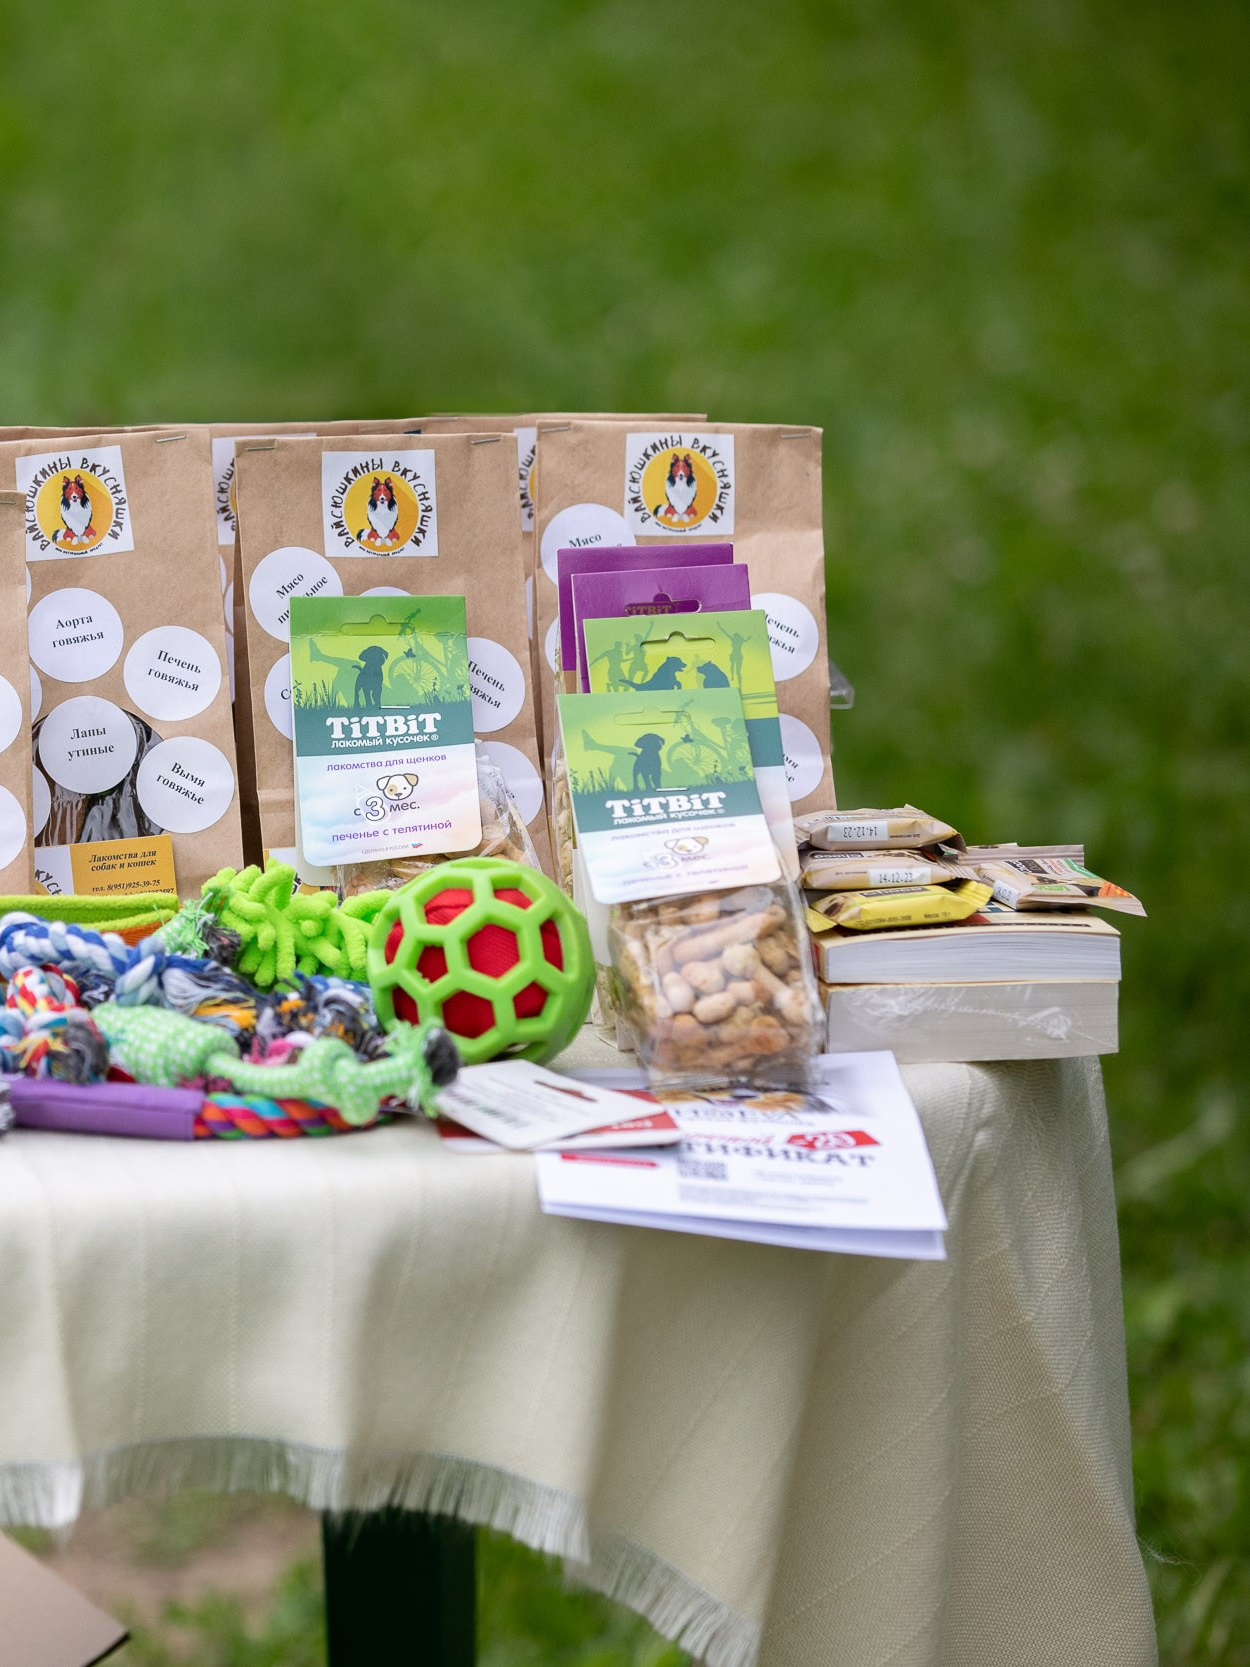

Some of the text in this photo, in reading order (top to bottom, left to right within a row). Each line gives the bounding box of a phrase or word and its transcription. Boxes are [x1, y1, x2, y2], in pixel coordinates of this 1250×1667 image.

[628, 434, 731, 524] ВАЙСЮШКИНЫ ВКУСНЯШКИ
[80, 457, 127, 540] ВКУСНЯШКИ
[331, 457, 433, 548] ВАЙСЮШКИНЫ ВКУСНЯШКИ
[569, 533, 602, 547] Мясо
[276, 573, 305, 600] Мясо
[55, 614, 94, 630] Аорта
[765, 613, 800, 639] ечень
[52, 631, 104, 648] говяжья
[157, 650, 202, 675] Печень
[147, 667, 200, 692] говяжья
[468, 661, 506, 692] Печень
[70, 726, 107, 740] Лапы
[325, 712, 442, 739] TiTBiT
[67, 743, 115, 761] утиные
[331, 733, 431, 749] лакомый кусочек
[171, 762, 206, 788] Вымя
[326, 753, 447, 772] лакомства для щенков
[156, 773, 205, 806] говяжье
[353, 796, 420, 822] с 3 мес.
[605, 791, 727, 818] TiTBiT
[613, 809, 717, 825] лакомый кусочек
[331, 819, 452, 842] печенье с телятиной
[843, 826, 878, 838] 14.12.23
[88, 850, 157, 863] Лакомства для
[91, 863, 118, 872] собак
[127, 859, 157, 868] кошек
[878, 872, 914, 884] 14.12.23
[683, 1141, 875, 1167] ТИФИКАТ
